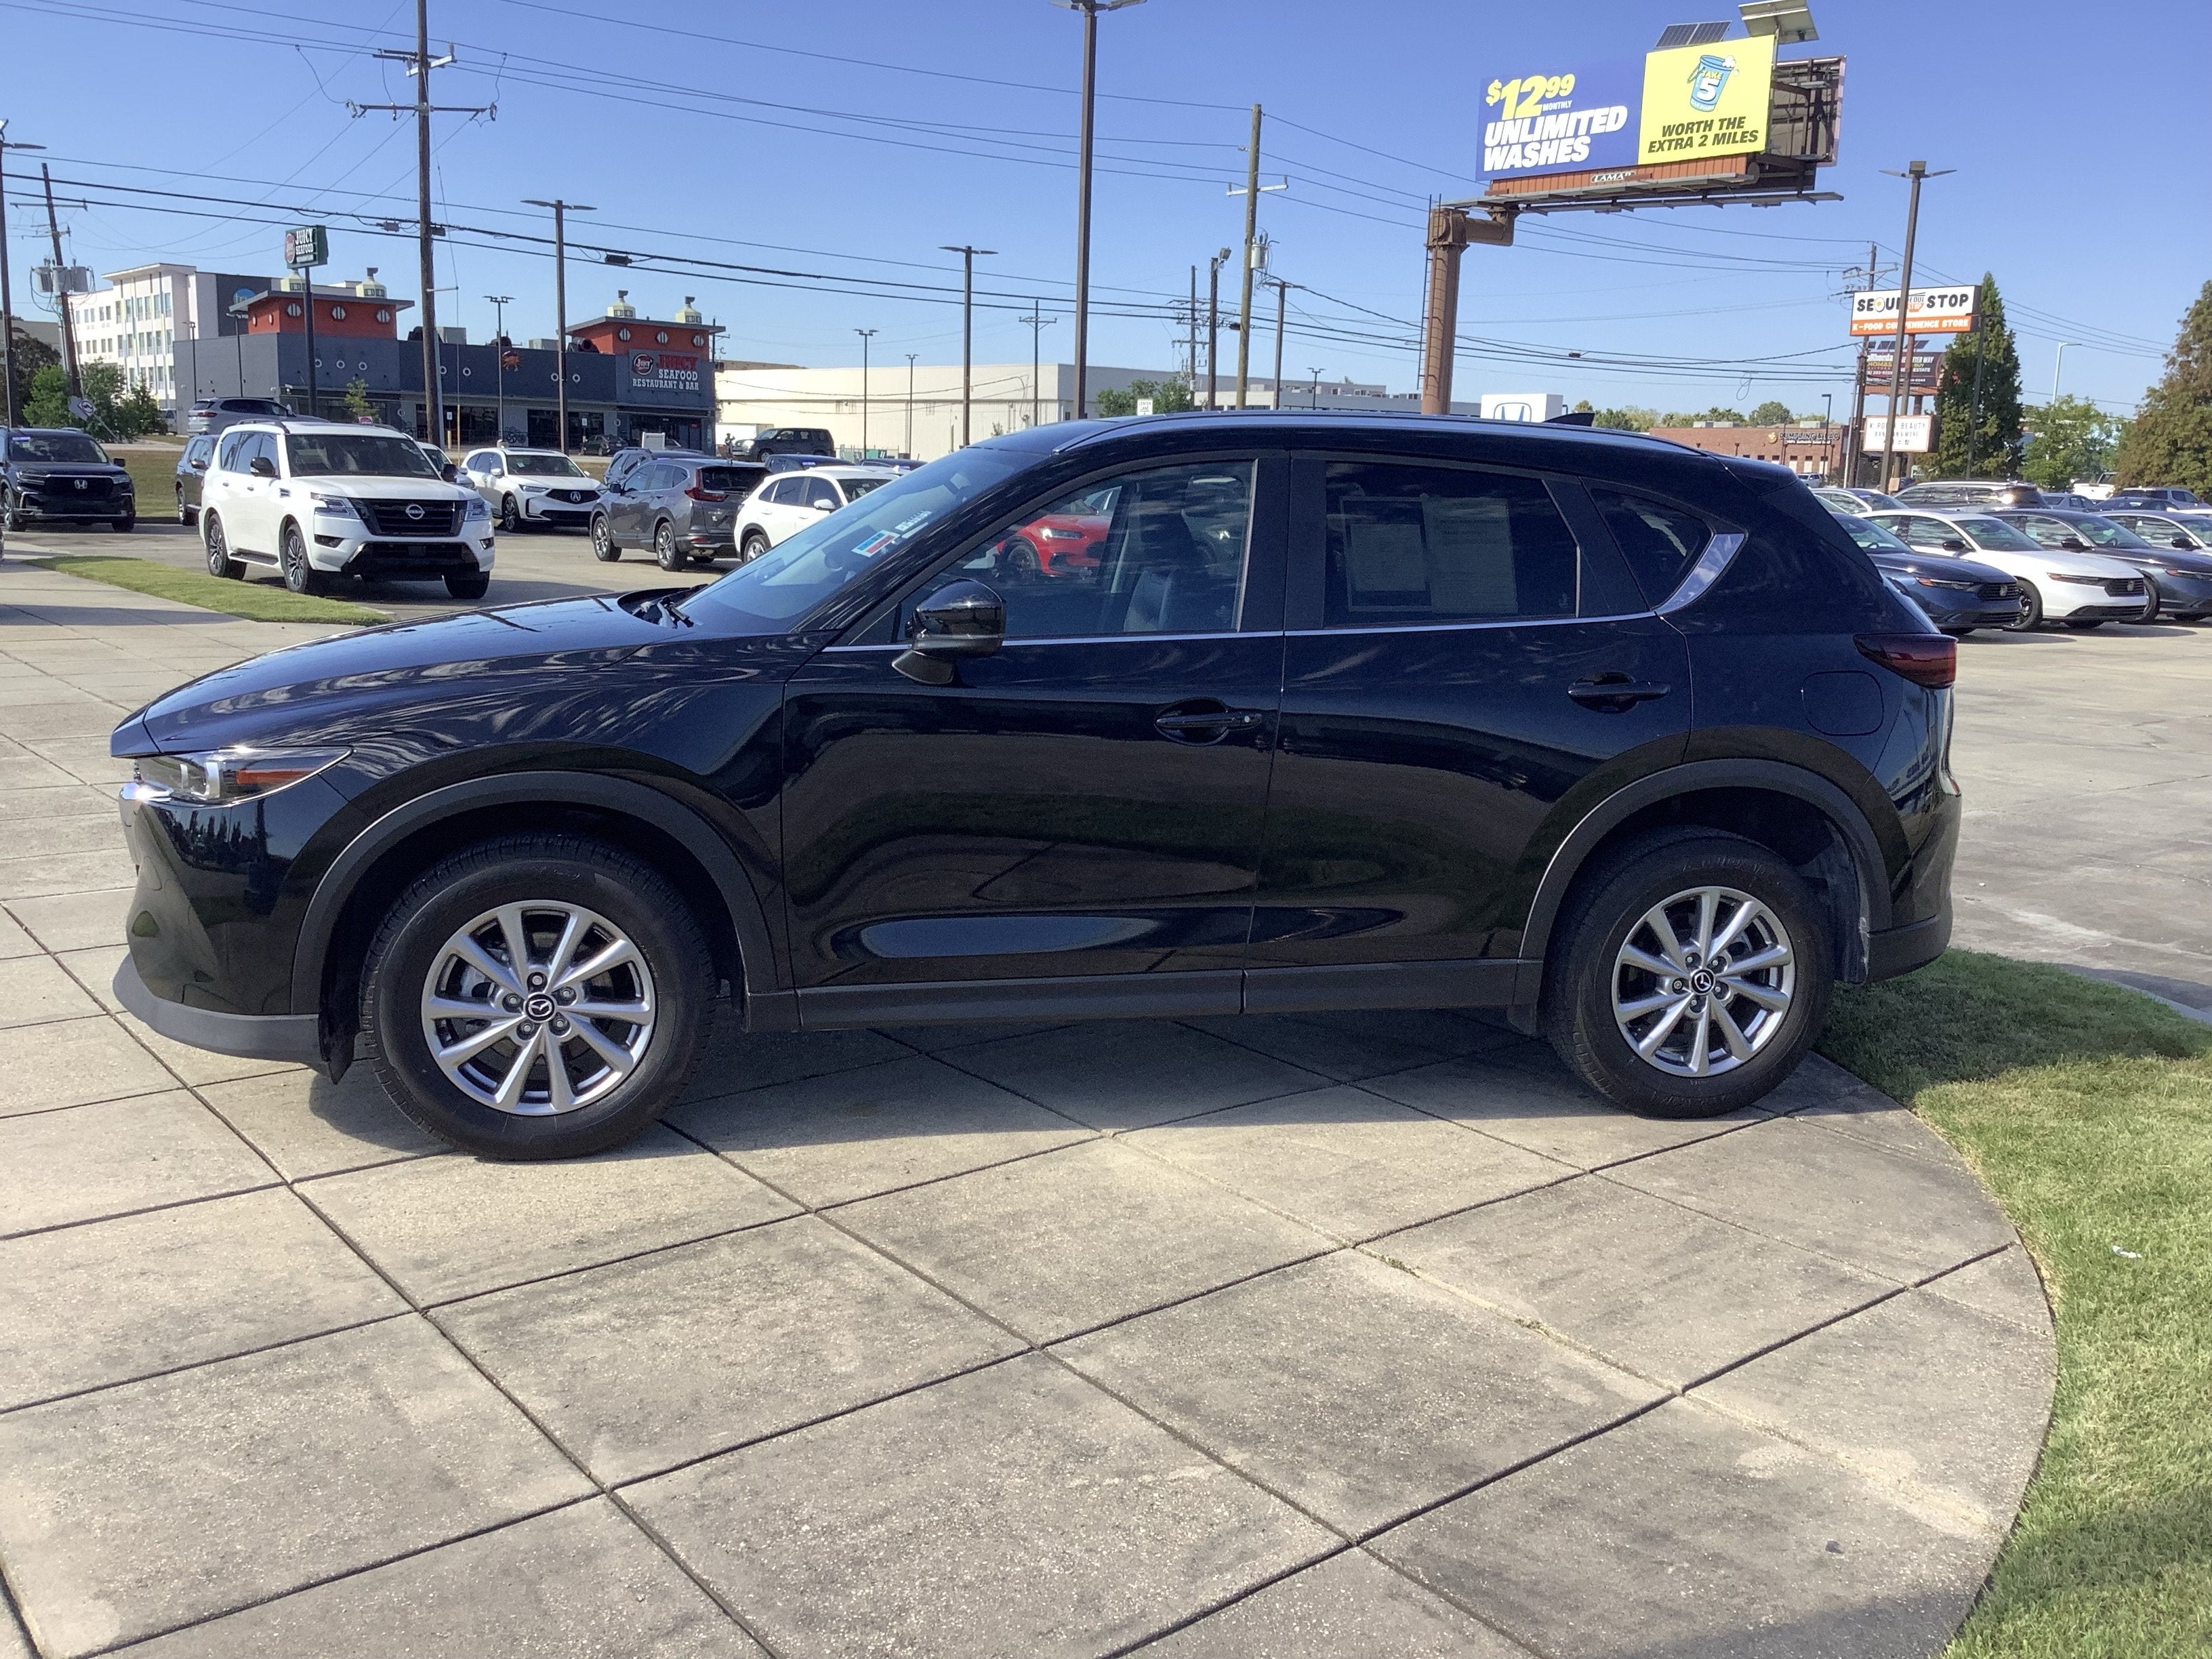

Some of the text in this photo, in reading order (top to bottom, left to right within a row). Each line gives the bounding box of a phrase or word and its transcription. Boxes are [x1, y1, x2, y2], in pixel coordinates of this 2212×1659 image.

[1696, 77, 1720, 102] 5
[1542, 100, 1572, 111] MONTHLY
[1484, 105, 1628, 147] UNLIMITED
[1662, 116, 1746, 138] WORTH THE
[1647, 129, 1759, 153] EXTRA 2 MILES
[1483, 136, 1591, 171] WASHES
[295, 228, 313, 245] JUICY
[1927, 293, 1969, 308] STOP
[1885, 320, 1940, 330] CONENIENCE
[1942, 319, 1969, 328] STORE
[659, 369, 698, 381] SEAFOOD
[632, 378, 699, 390] RESTAURANT & BAR
